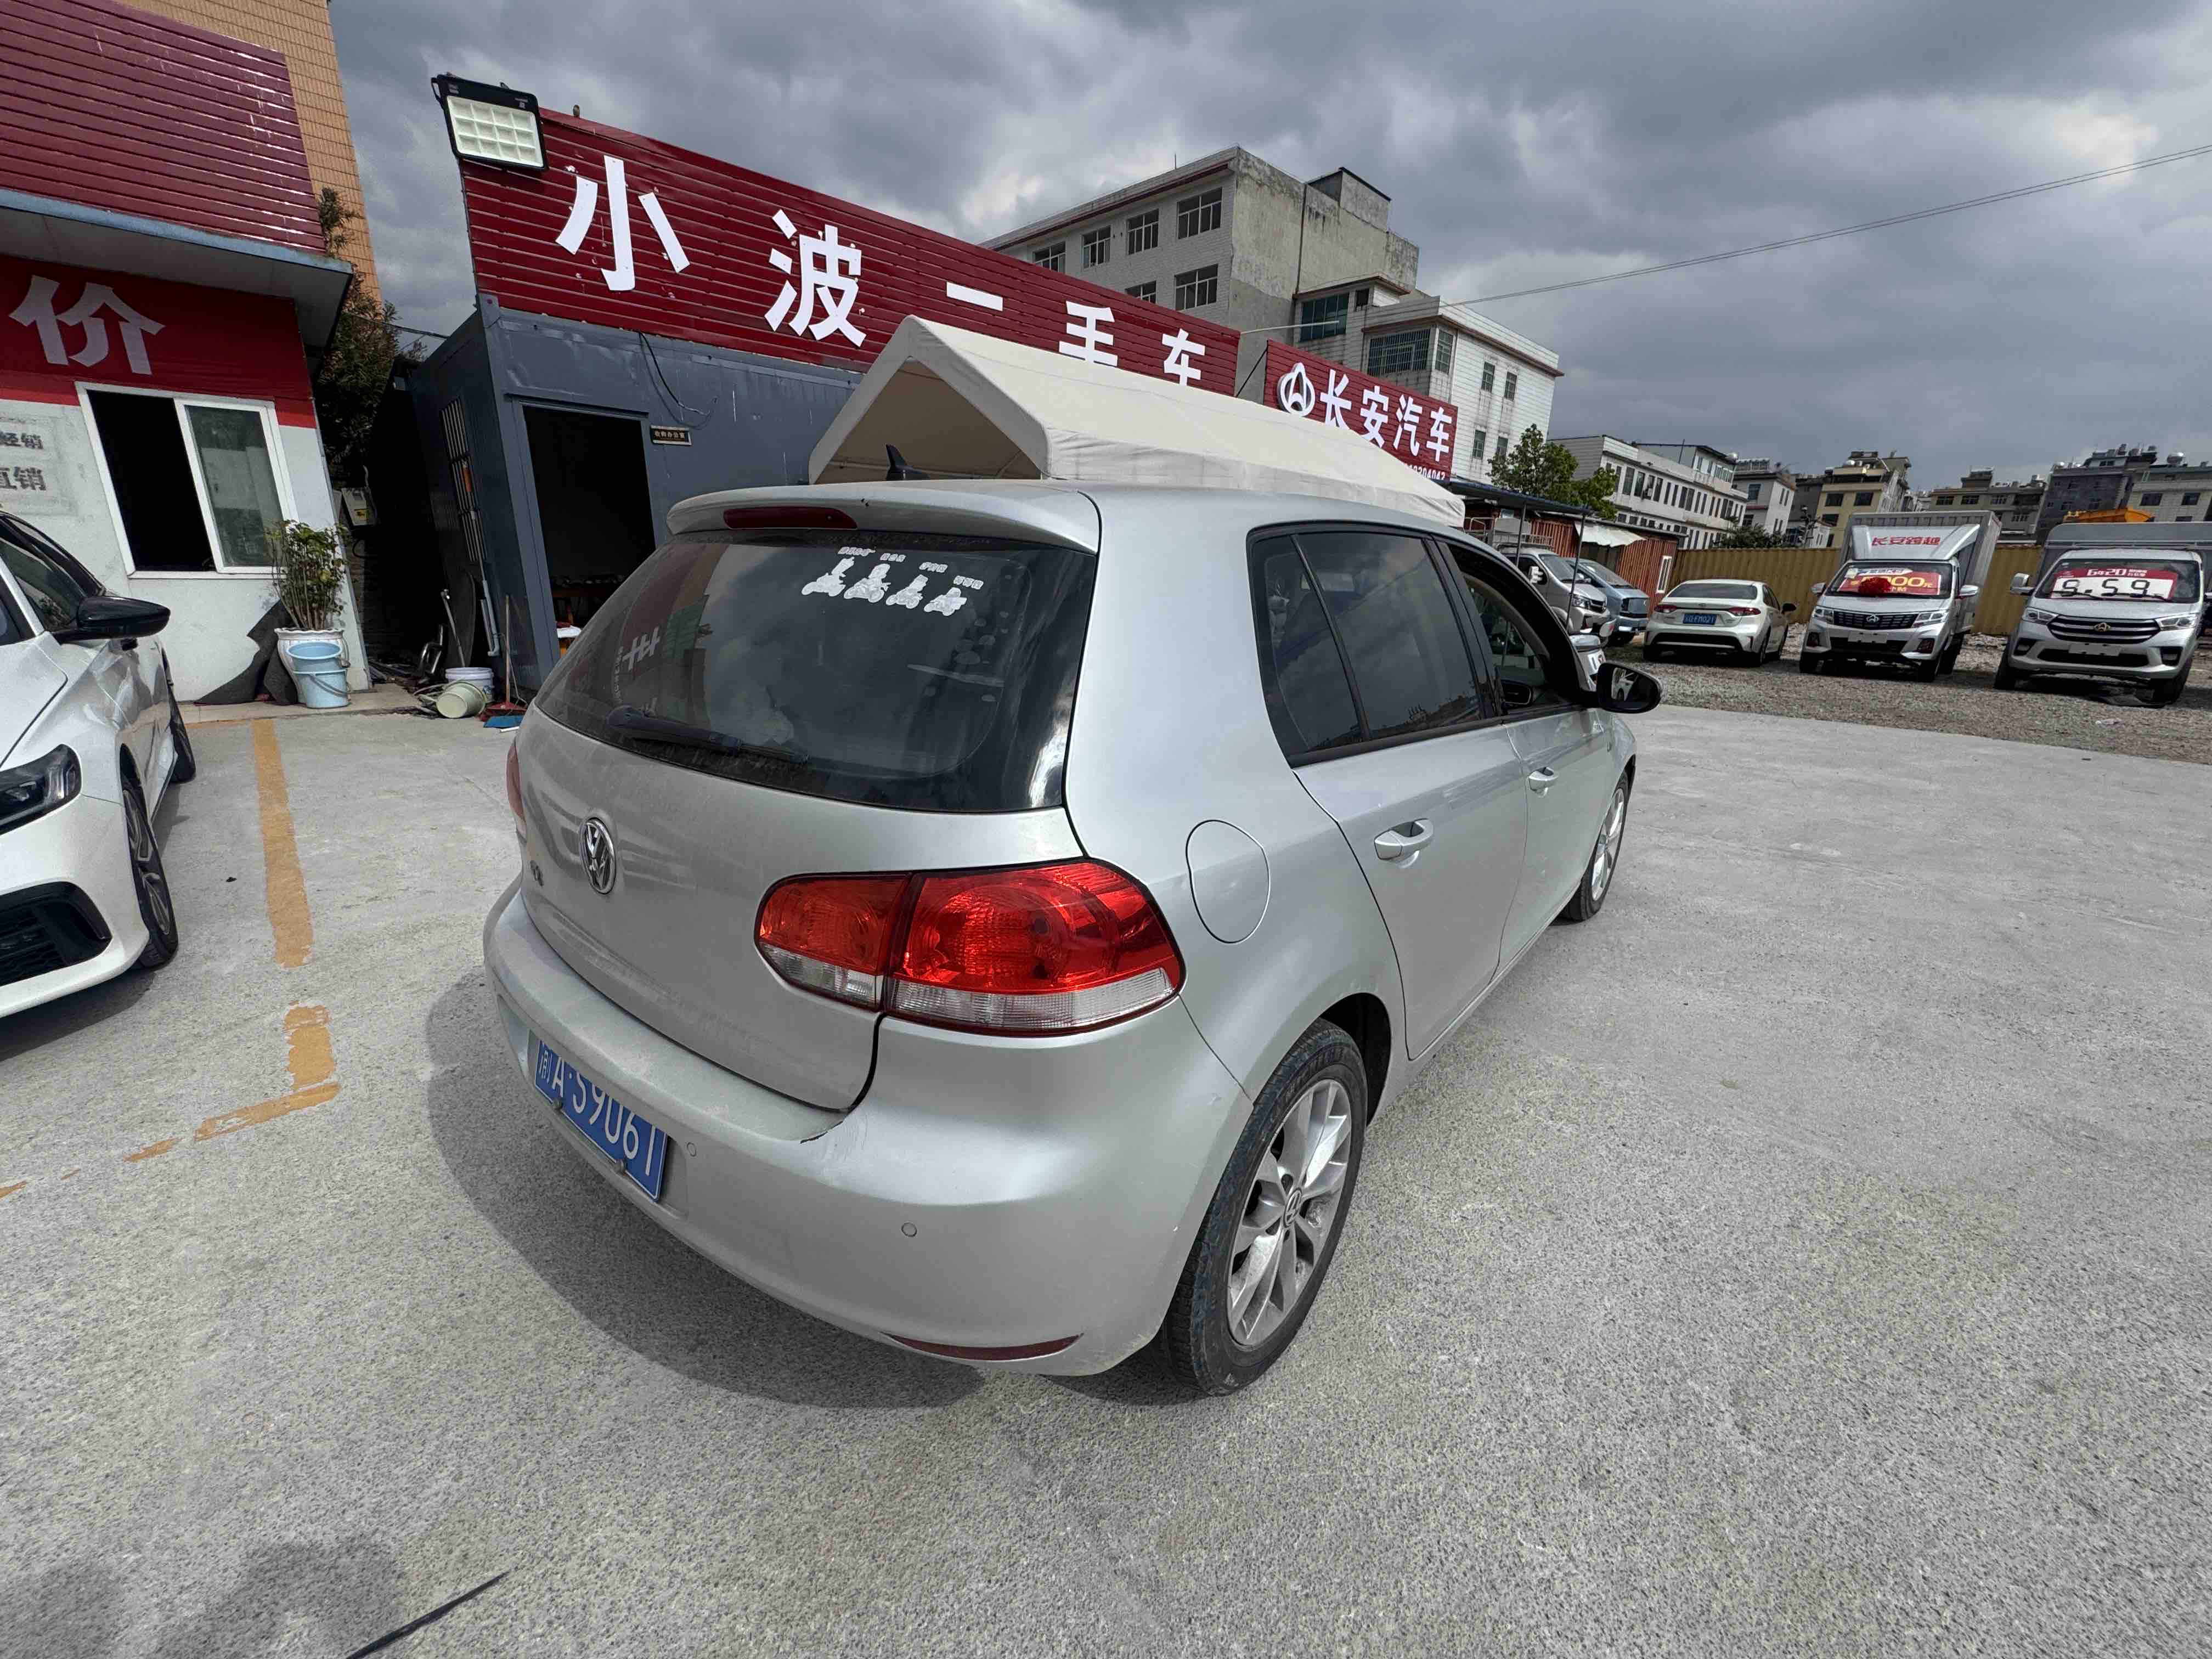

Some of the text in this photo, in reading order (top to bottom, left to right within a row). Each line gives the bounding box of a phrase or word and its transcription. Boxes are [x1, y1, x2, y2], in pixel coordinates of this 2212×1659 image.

[8, 275, 166, 376] 价
[1319, 369, 1453, 462] 长安汽车
[1871, 537, 1940, 546] 长安跨越
